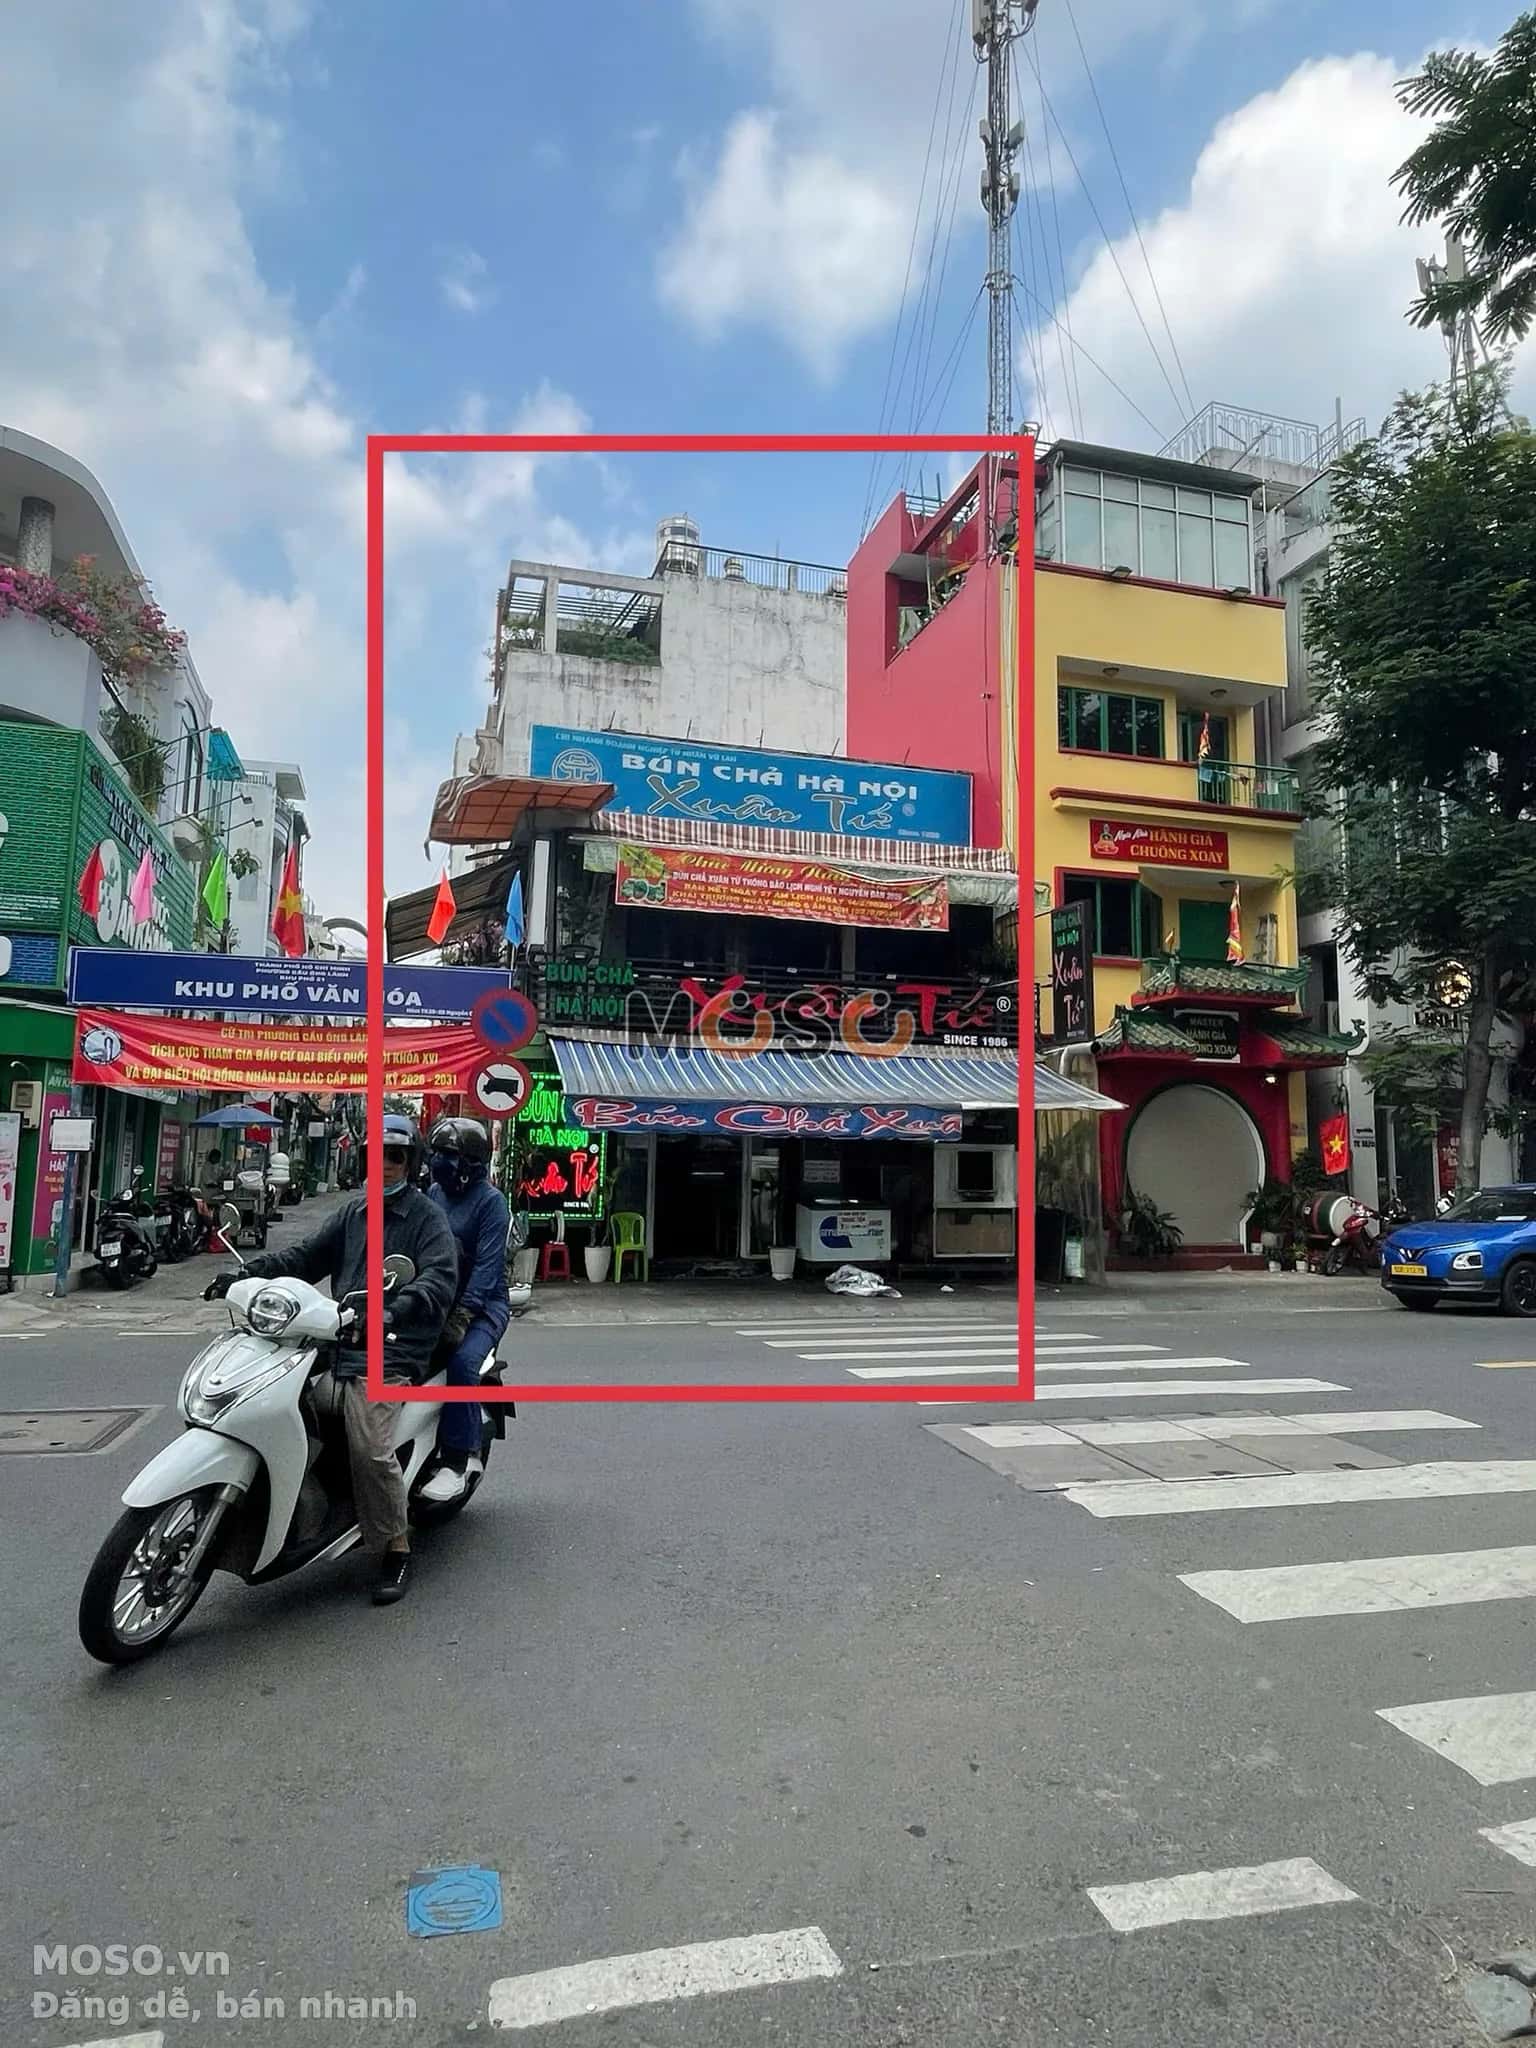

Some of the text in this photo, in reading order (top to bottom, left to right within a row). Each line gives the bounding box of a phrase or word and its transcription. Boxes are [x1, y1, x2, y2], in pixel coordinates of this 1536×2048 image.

[621, 753, 918, 802] BÚN CHẢ HÀ NỘI
[646, 774, 894, 832] Xuân Tứ
[1129, 844, 1224, 864] CHUÔNG XOAY
[546, 960, 635, 985] BÚN CHẢ
[174, 980, 422, 1007] KHU PHỐ VĂN ÓA
[555, 992, 625, 1021] HÀ NỘI
[238, 1028, 255, 1040] TRI
[943, 1034, 1008, 1048] SINCE 1986
[150, 1043, 176, 1058] TÍCH
[177, 1045, 200, 1061] CỰC
[202, 1047, 233, 1060] THAM
[235, 1048, 254, 1061] GIA
[343, 1048, 368, 1066] QUỐ
[392, 1050, 420, 1065] KHÓA
[422, 1052, 439, 1064] XVI
[125, 1064, 140, 1079] VÀ
[245, 1069, 276, 1084] NHÂN
[278, 1069, 301, 1084] DÂN
[302, 1070, 325, 1085] CÁC
[434, 1073, 457, 1086] 2031
[572, 1097, 707, 1129] Bún
[713, 1105, 851, 1135] Chả
[557, 1128, 589, 1151] NỘI
[569, 1151, 600, 1199] Tứ
